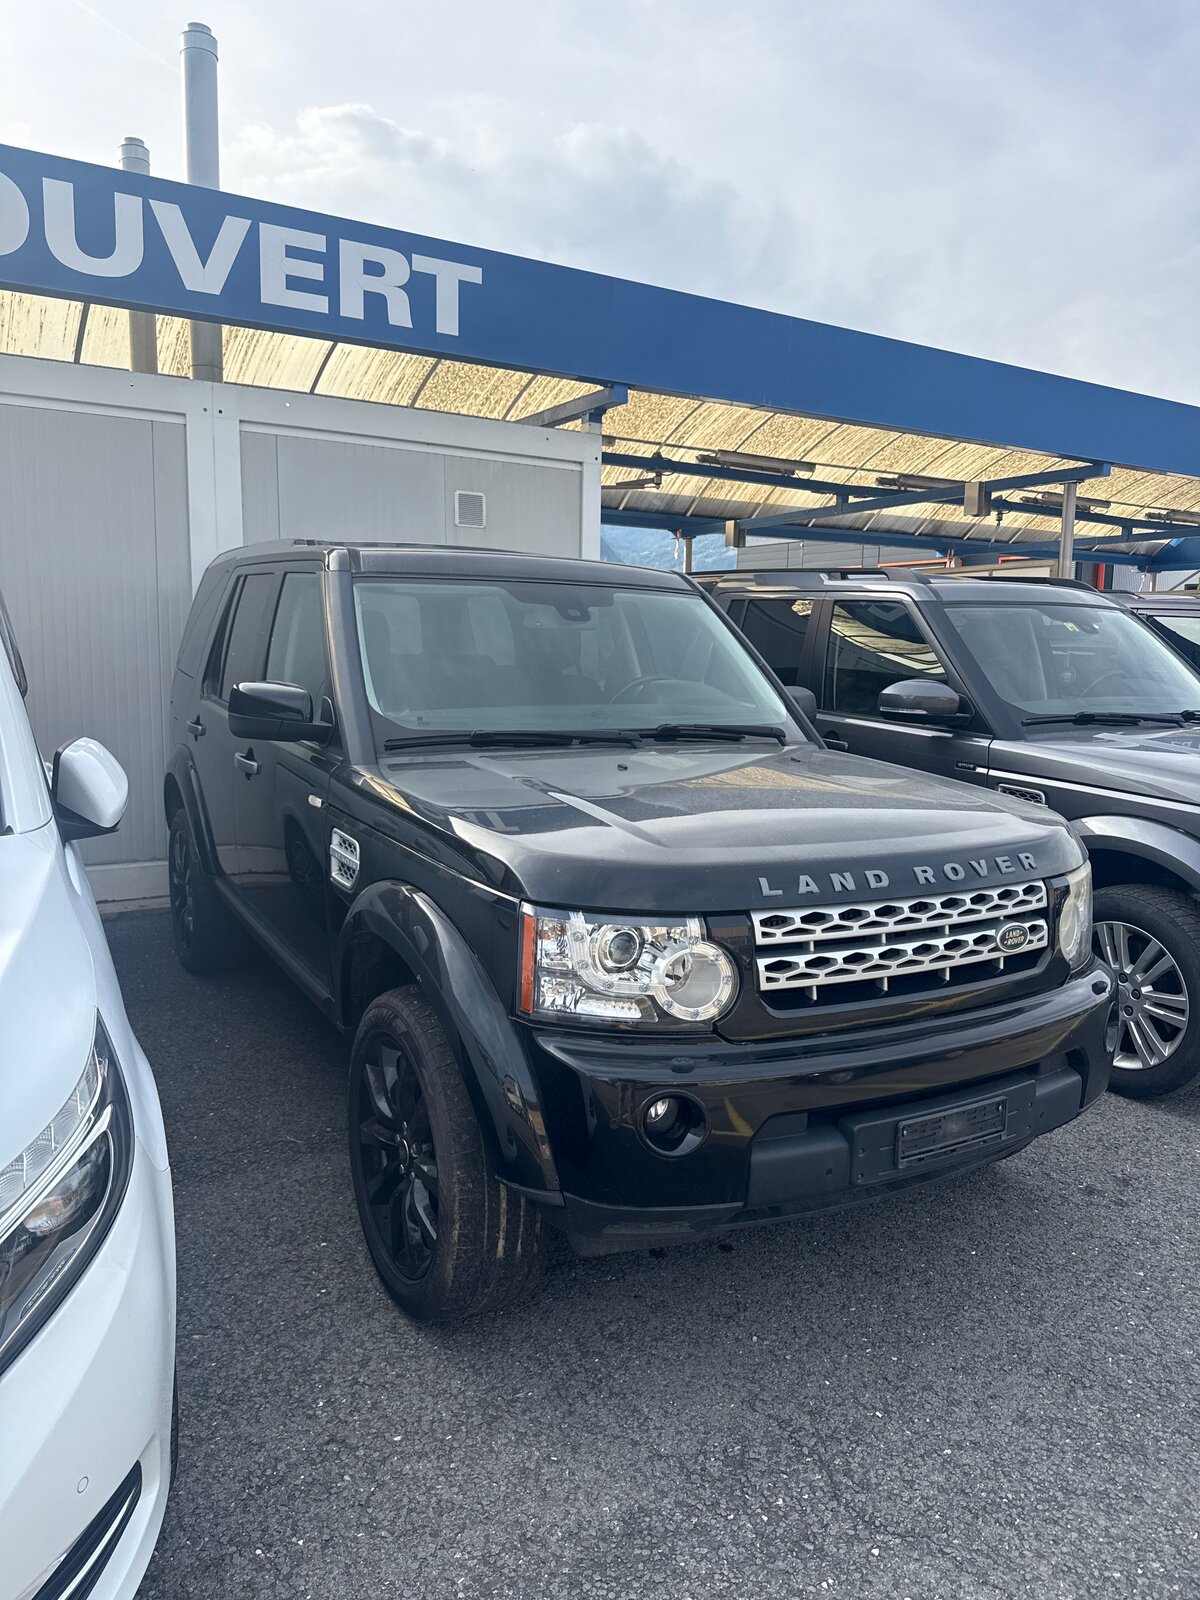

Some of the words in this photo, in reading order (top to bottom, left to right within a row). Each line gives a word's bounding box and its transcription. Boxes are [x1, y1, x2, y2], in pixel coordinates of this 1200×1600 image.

[0, 171, 483, 337] UVERT
[758, 869, 890, 897] LAND
[912, 852, 1038, 885] ROVER
[1005, 929, 1021, 939] LAND
[1006, 935, 1025, 946] ROVER
